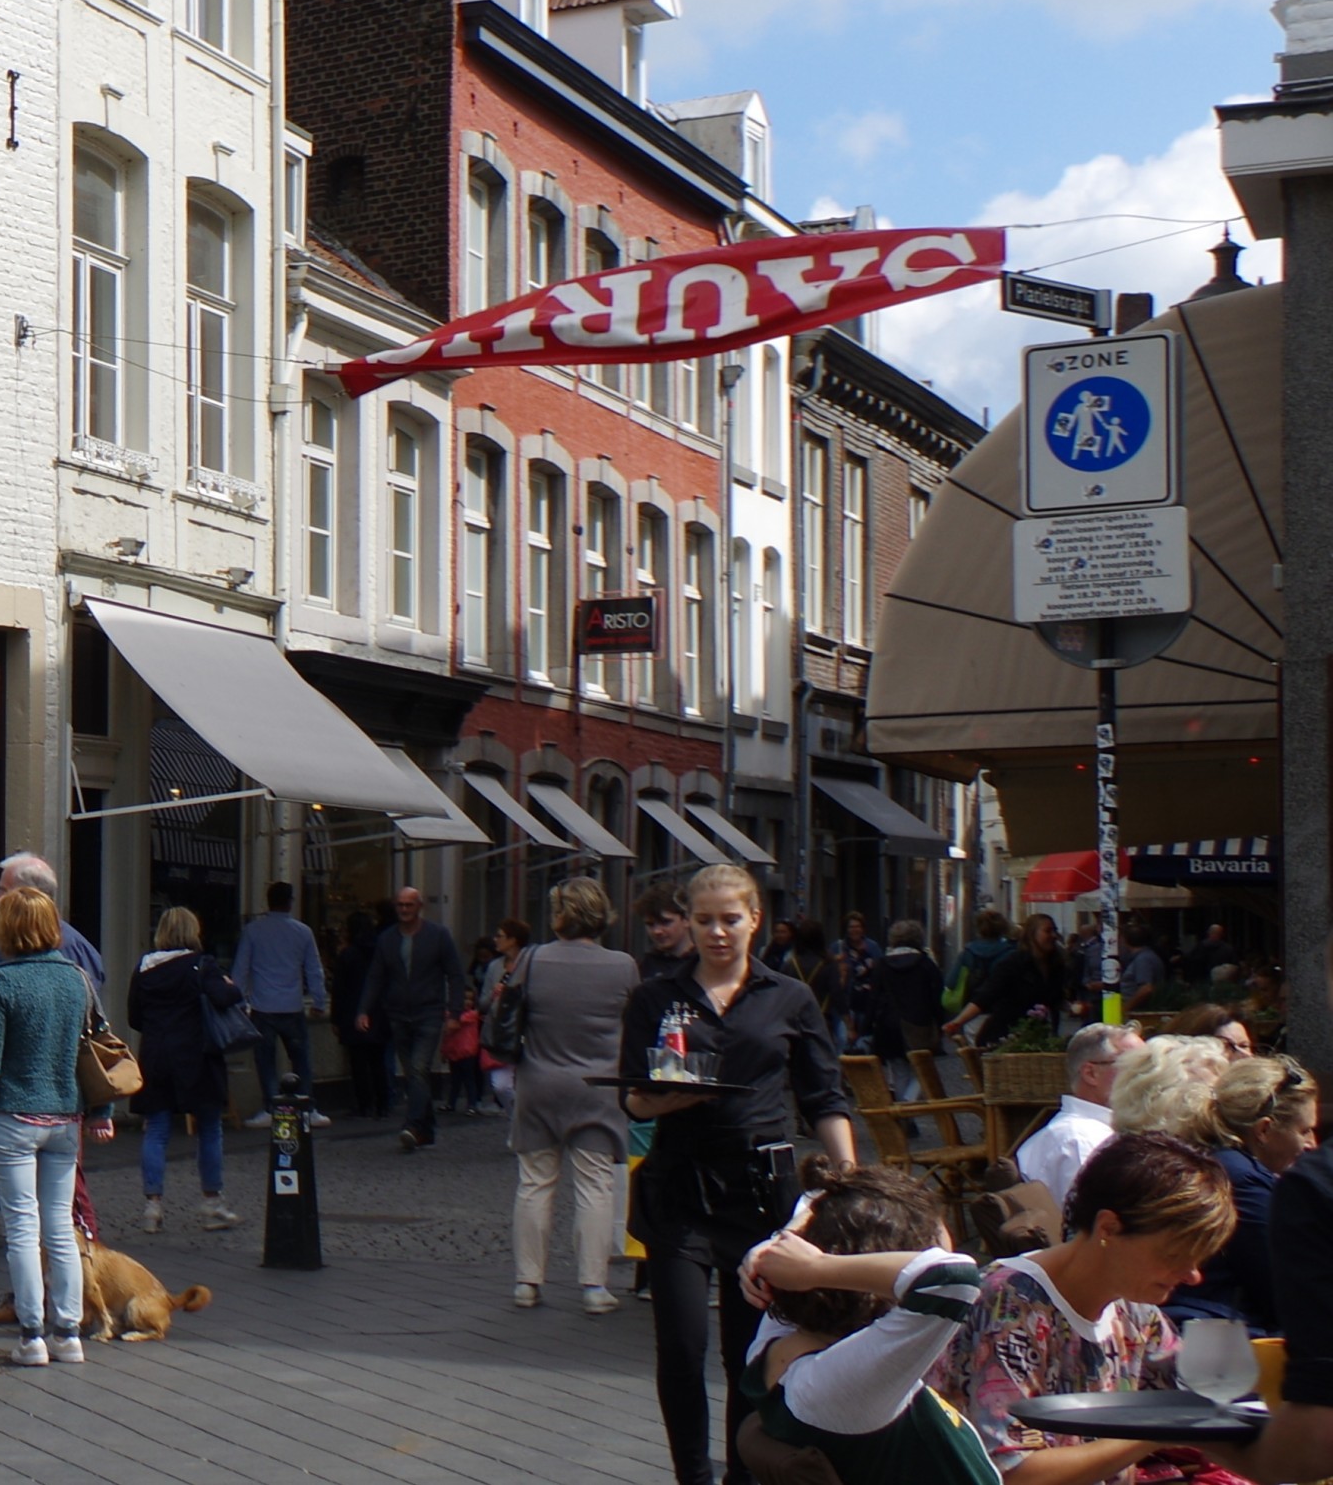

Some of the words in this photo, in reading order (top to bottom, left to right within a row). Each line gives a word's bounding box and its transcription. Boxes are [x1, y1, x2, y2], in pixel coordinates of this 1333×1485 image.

[1065, 350, 1128, 370] ZONE
[587, 607, 650, 631] ARISTO
[1189, 857, 1270, 873] Bavaria
